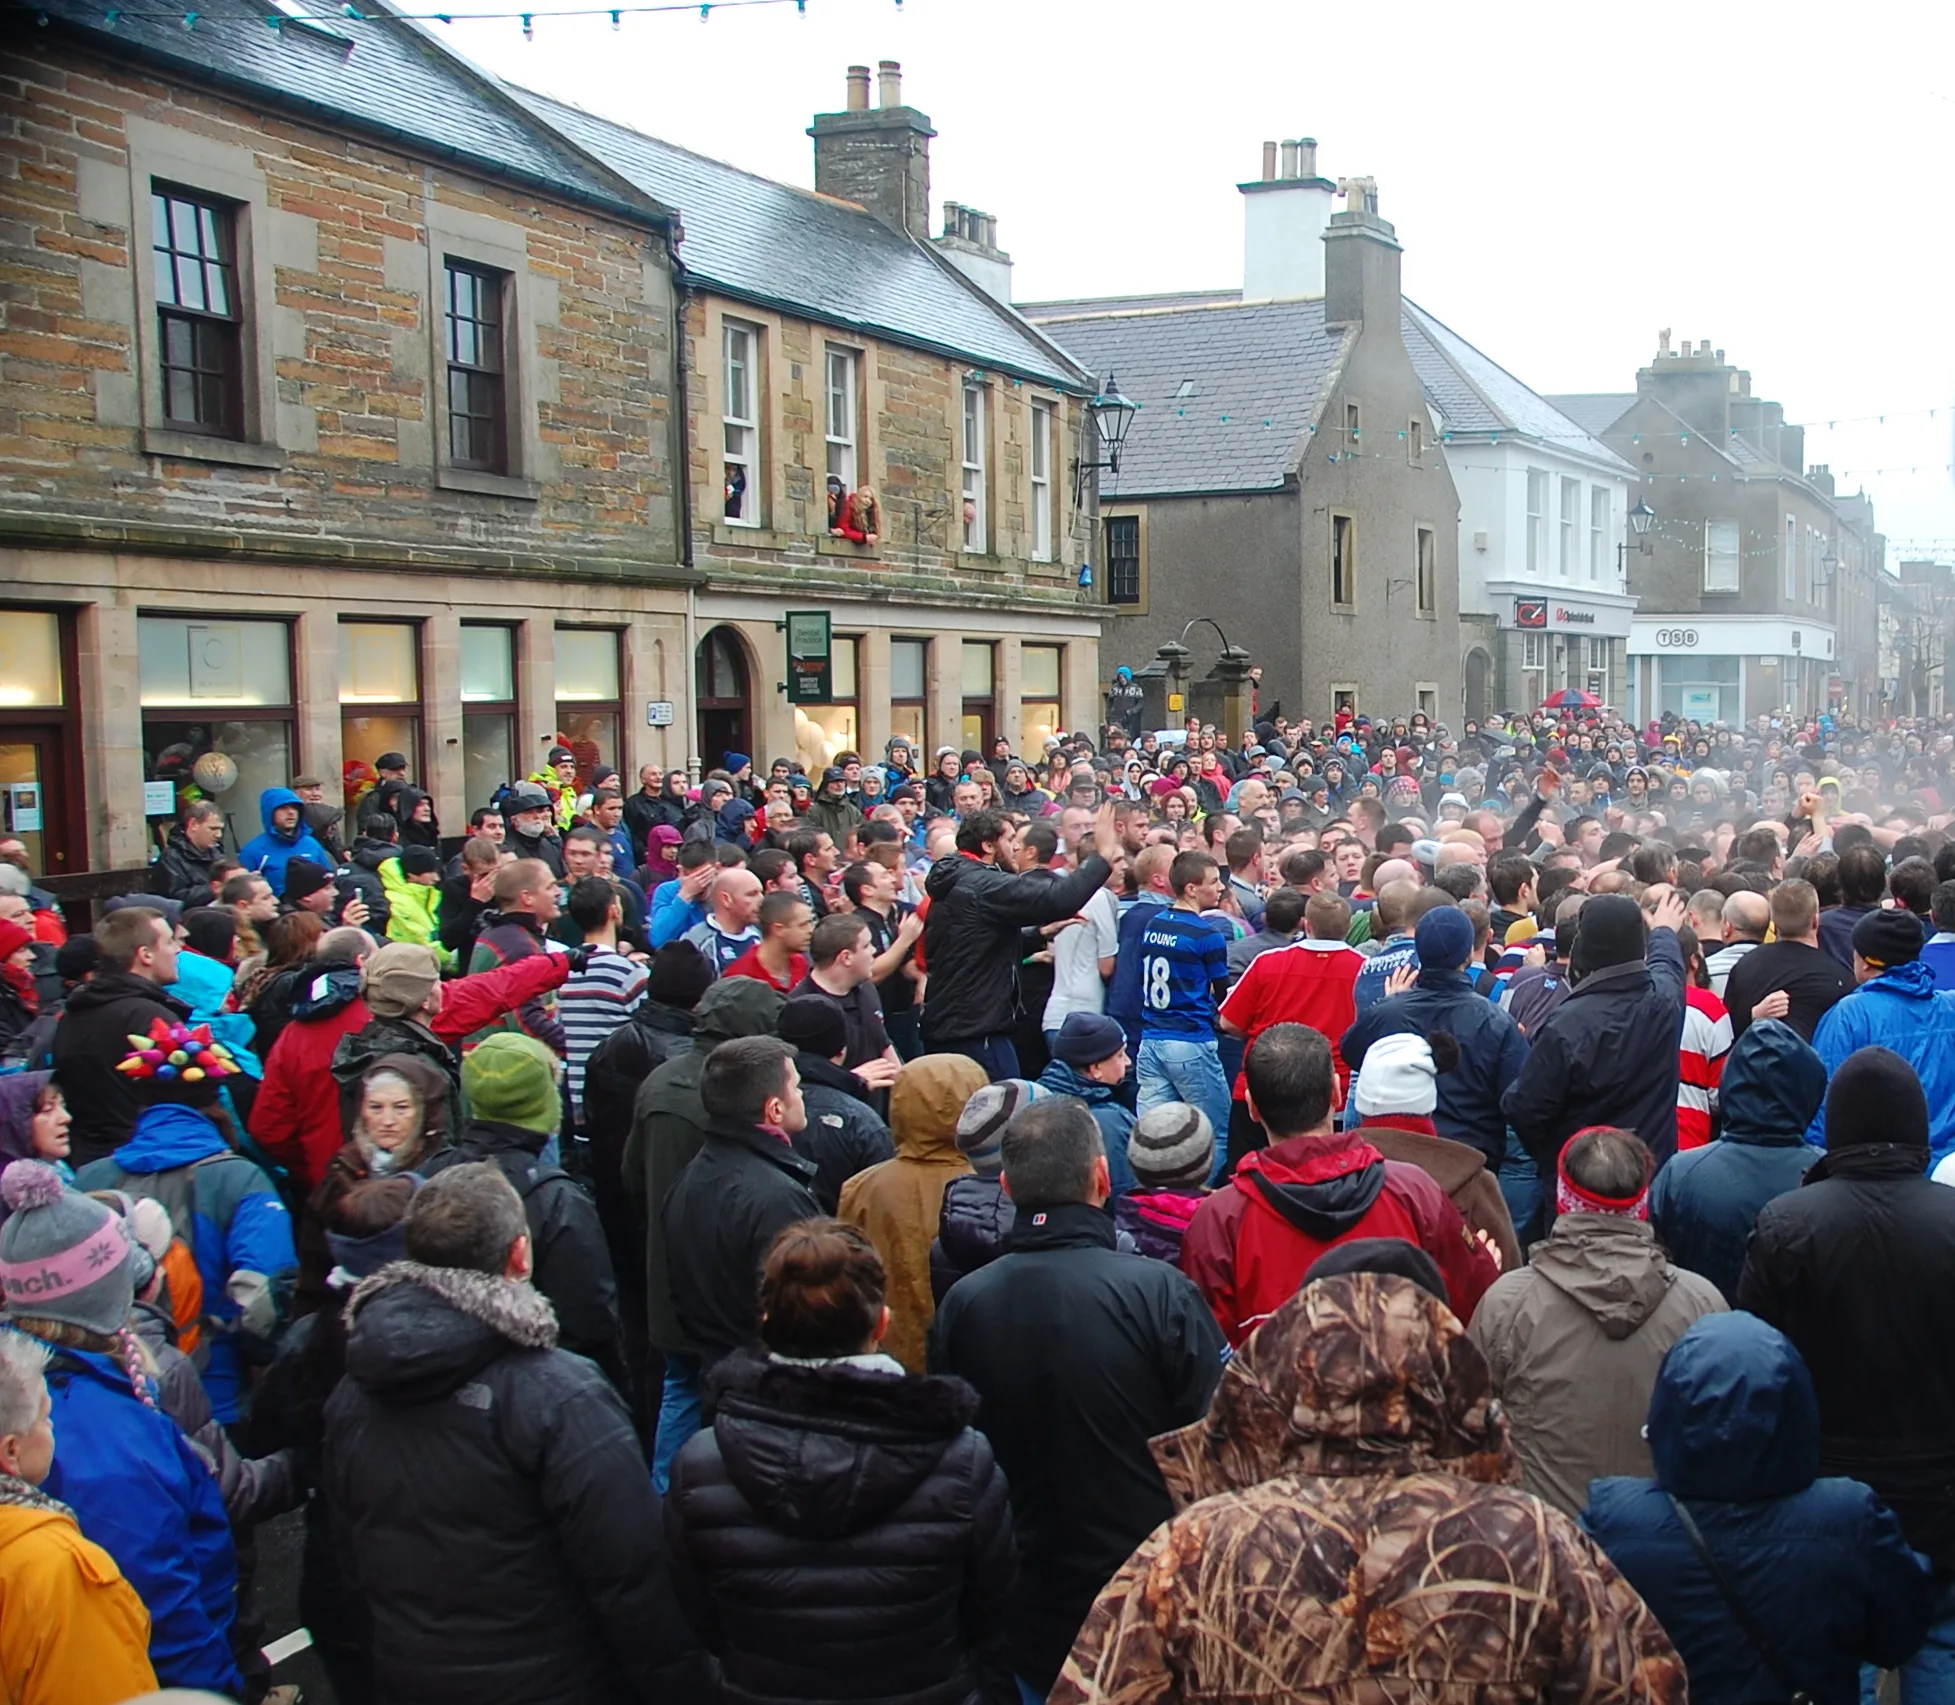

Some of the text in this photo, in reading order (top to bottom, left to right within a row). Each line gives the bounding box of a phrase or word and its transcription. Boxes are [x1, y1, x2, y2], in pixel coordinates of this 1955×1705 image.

[1658, 630, 1697, 645] TSB
[1144, 931, 1177, 947] YOUNG
[1143, 954, 1170, 1009] 18
